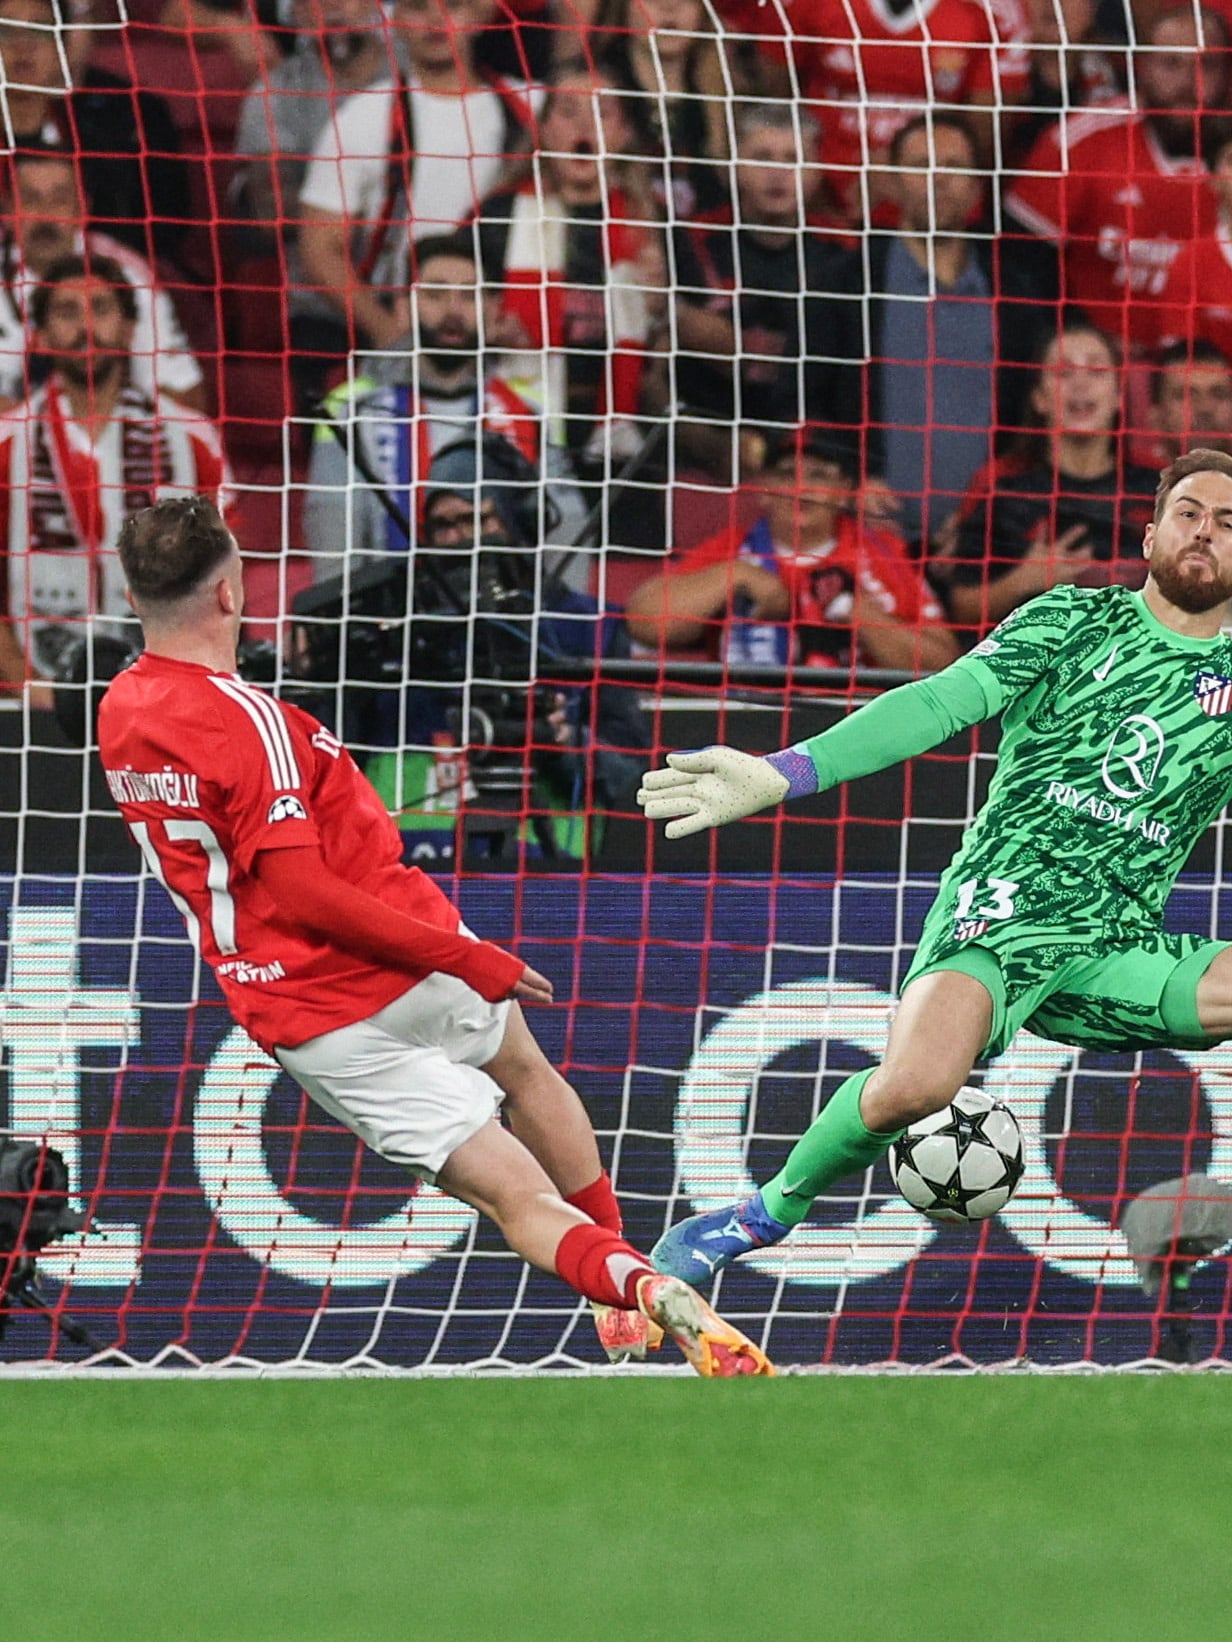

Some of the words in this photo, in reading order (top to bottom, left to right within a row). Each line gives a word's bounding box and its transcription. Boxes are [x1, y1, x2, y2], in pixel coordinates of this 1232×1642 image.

[1046, 781, 1133, 832] RIYADH
[1133, 818, 1171, 847] AIR
[128, 819, 239, 957] 17
[954, 877, 1020, 920] 13
